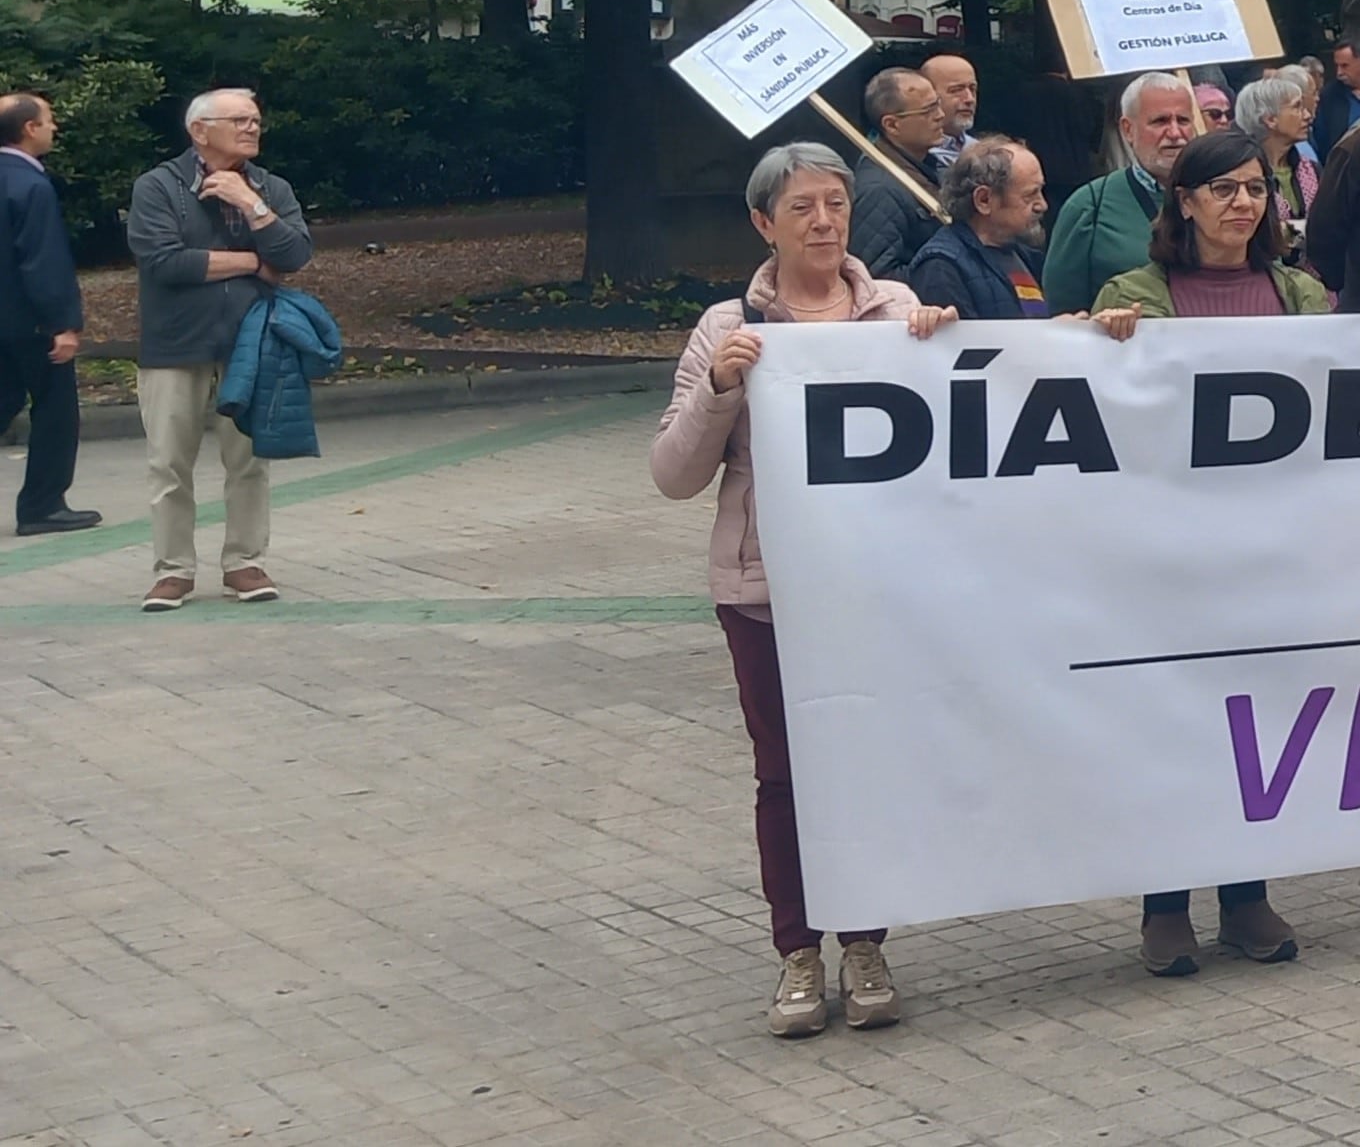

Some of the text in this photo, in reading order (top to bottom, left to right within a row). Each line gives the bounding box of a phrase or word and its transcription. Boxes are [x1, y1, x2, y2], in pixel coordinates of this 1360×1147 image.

[1123, 4, 1165, 16] Centros
[1168, 3, 1182, 13] de
[737, 22, 759, 41] MÁS
[1118, 31, 1228, 50] GESTIÓN PÚBLICA
[742, 27, 787, 63] INVERSIÓN
[772, 53, 787, 66] EN
[760, 47, 830, 102] SANIDAD PÚBLICA
[806, 349, 1119, 485] DÍA
